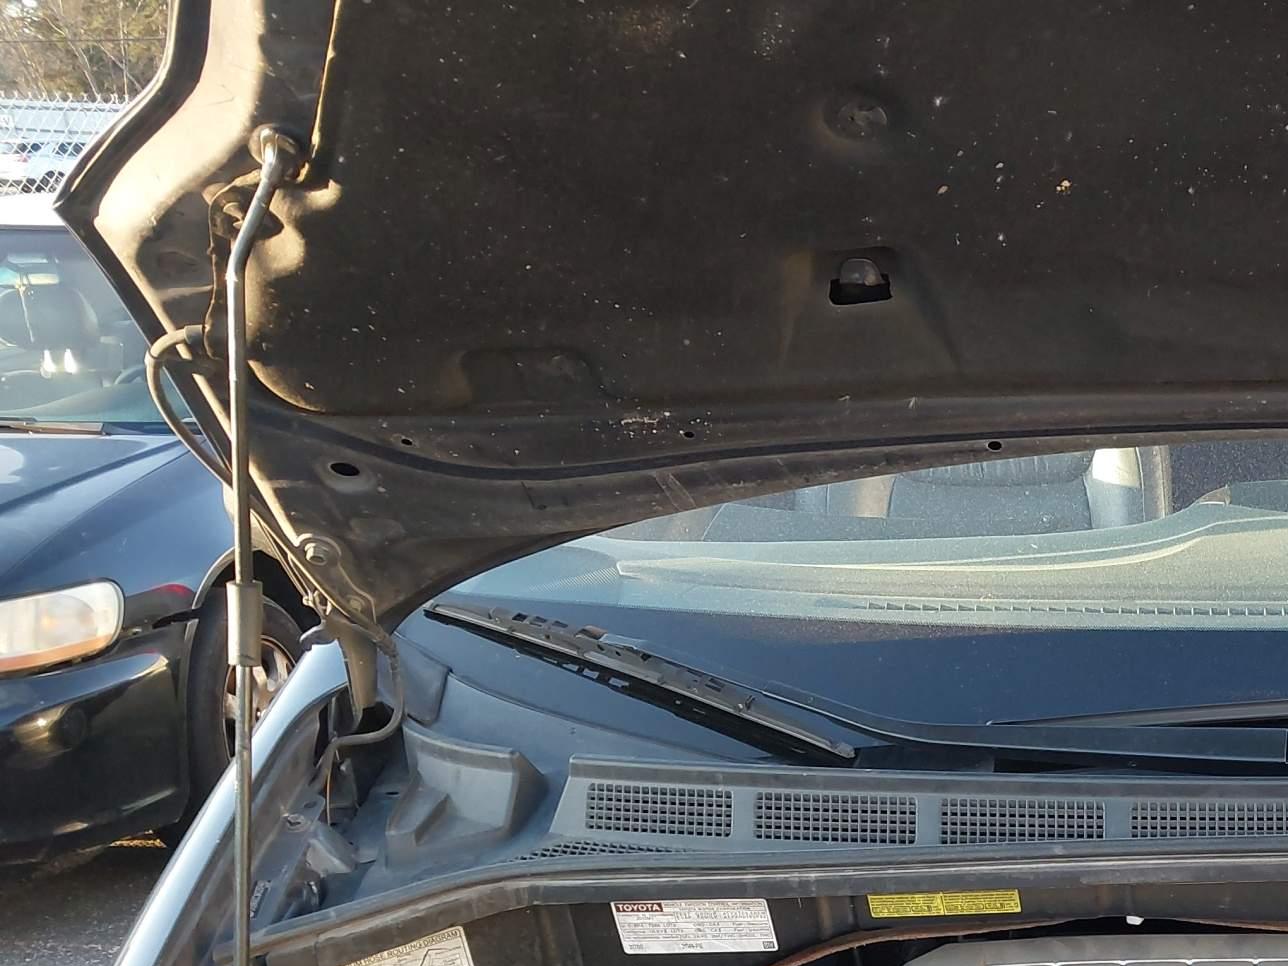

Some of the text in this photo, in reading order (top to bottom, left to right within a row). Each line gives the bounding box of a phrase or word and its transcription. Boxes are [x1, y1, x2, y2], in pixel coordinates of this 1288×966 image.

[616, 903, 661, 912] TOYOTA
[386, 942, 422, 958] ROUTING
[422, 930, 459, 948] DIAGRAM
